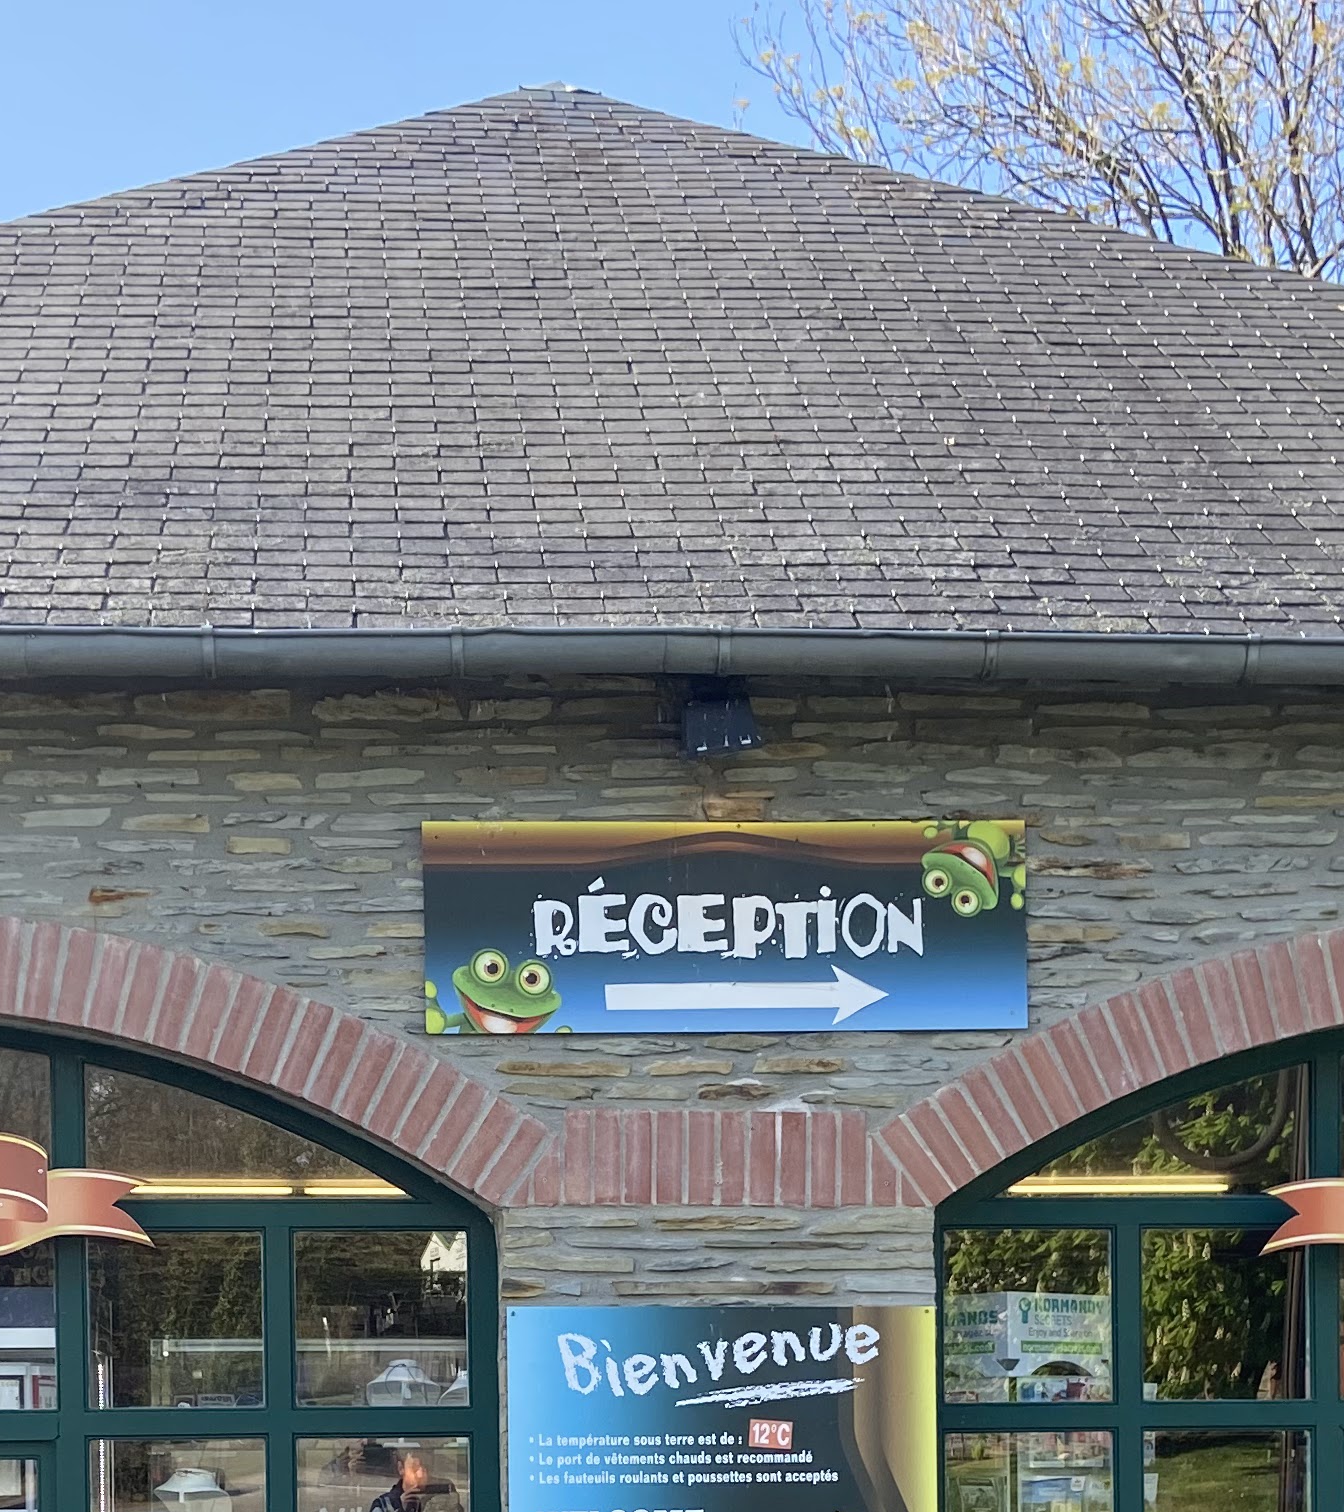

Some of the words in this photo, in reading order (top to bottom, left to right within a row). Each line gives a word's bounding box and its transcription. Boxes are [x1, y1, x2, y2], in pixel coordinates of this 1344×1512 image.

[532, 876, 924, 960] RÉCEPTION
[1034, 1297, 1105, 1316] NORMANDY
[556, 1322, 881, 1398] Bienvenue
[538, 1433, 553, 1447] La
[556, 1433, 630, 1449] température
[633, 1435, 662, 1446] sous
[664, 1433, 695, 1446] terre
[697, 1434, 717, 1446] est
[719, 1432, 735, 1446] de
[752, 1422, 790, 1447] 12°C
[538, 1452, 554, 1466] Le
[557, 1454, 582, 1469] port
[585, 1452, 601, 1466] de
[604, 1452, 666, 1465] vêtements
[668, 1451, 712, 1464] chauds
[714, 1452, 734, 1464] est
[736, 1450, 813, 1464] recommandé
[538, 1471, 560, 1485] Les
[563, 1470, 616, 1484] fauteuils
[619, 1470, 669, 1484] roulants
[672, 1471, 685, 1484] et
[687, 1470, 753, 1487] poussettes
[755, 1470, 782, 1483] sont
[784, 1468, 839, 1485] acceptés
